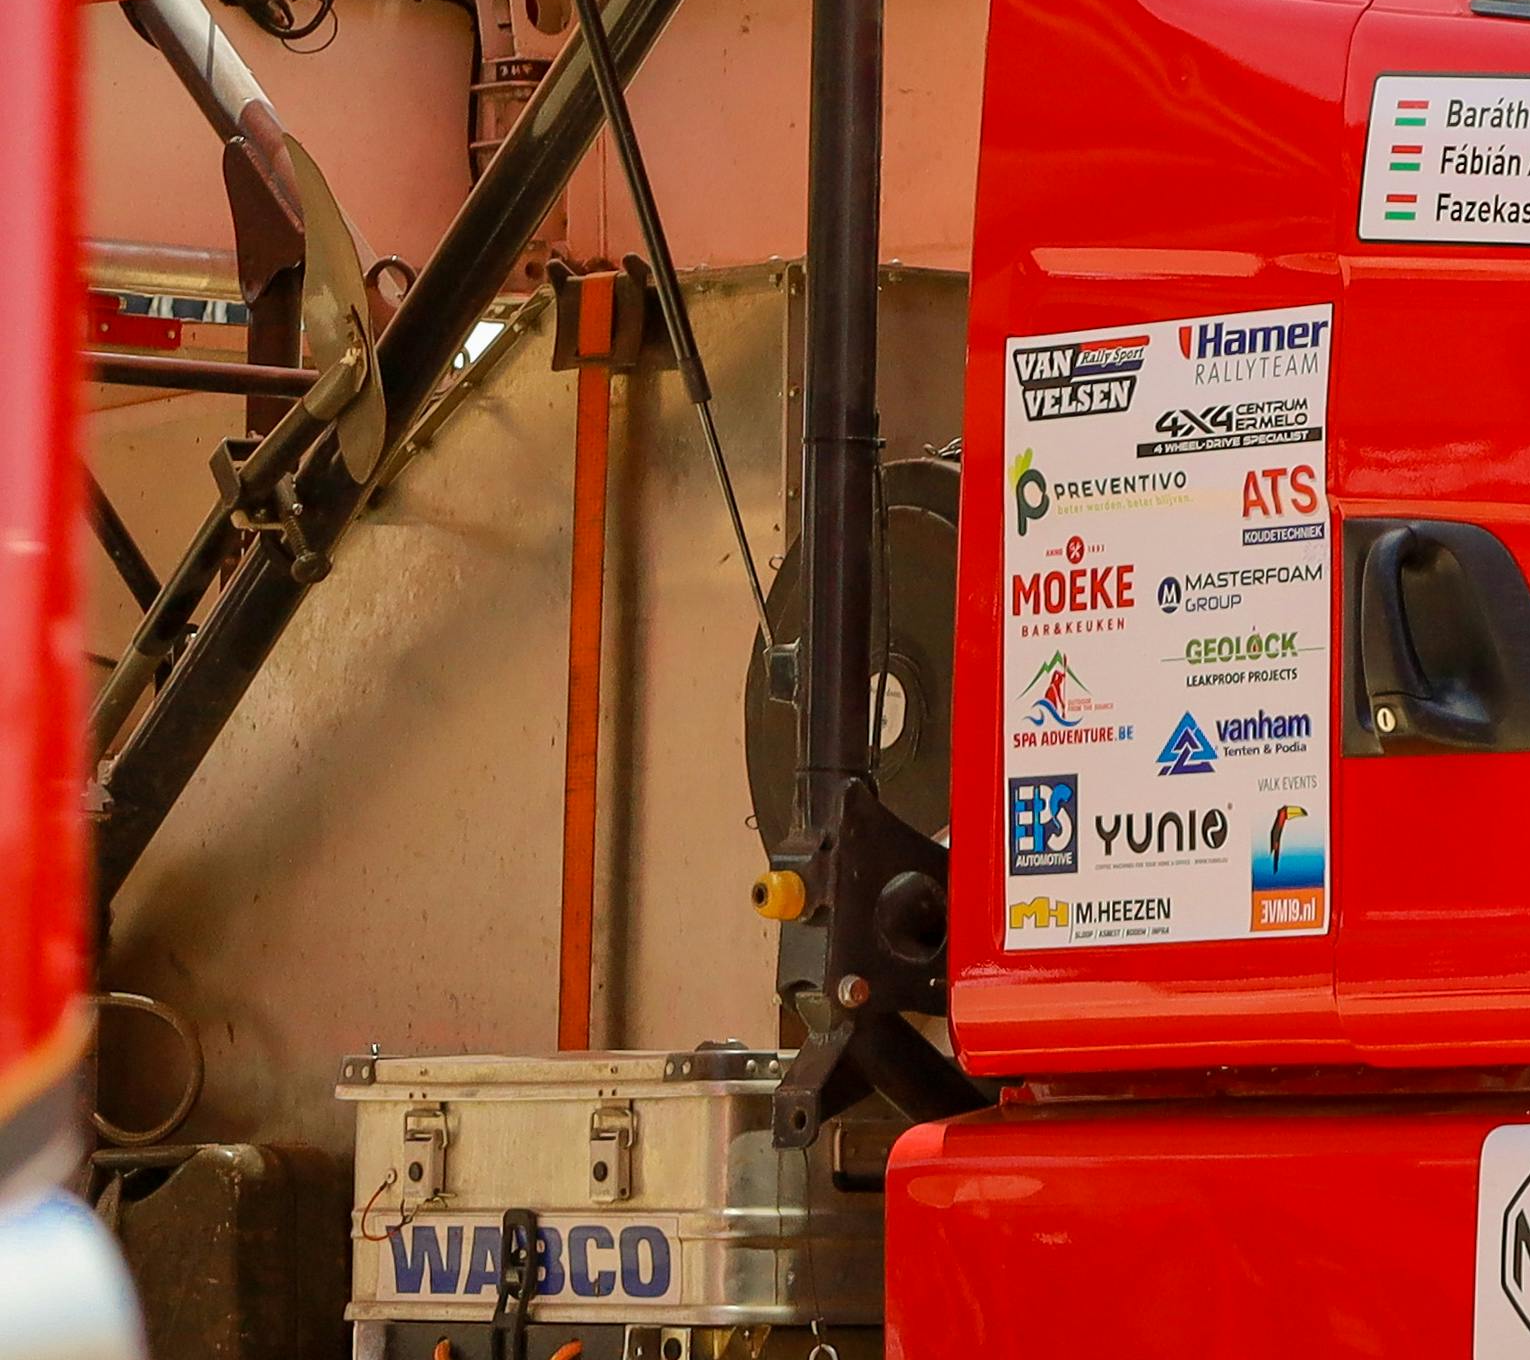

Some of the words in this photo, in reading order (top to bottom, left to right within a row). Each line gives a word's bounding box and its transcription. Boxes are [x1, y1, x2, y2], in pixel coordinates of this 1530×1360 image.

[1446, 97, 1529, 130] Baráth
[1440, 143, 1520, 176] Fábián
[1198, 320, 1329, 360] Hamer
[1015, 348, 1074, 383] VAN
[1080, 349, 1112, 367] Rally
[1111, 346, 1146, 362] Sport
[1195, 352, 1319, 385] RALLYTEAM
[1023, 380, 1132, 418] VELSEN
[1235, 398, 1308, 415] CENTRUM
[1235, 412, 1308, 431] ERMELO
[1153, 444, 1163, 455] 4
[1242, 430, 1311, 447] SPECIALIST
[1054, 471, 1187, 500] PREVENTIVO
[1242, 465, 1318, 519] ATS
[1244, 523, 1323, 545] KOUDETECHNIEK
[1012, 564, 1134, 616] MOEKE
[1185, 563, 1323, 590] MASTERFOAM
[1185, 594, 1242, 612] GROUP
[1021, 617, 1125, 637] BAR&KEUKEN
[1186, 630, 1299, 665] GEOLOCK
[1186, 670, 1246, 687] LEAKPROOF
[1248, 667, 1298, 682] PROJECTS
[1216, 709, 1311, 742] vanham
[1013, 731, 1038, 748] SPA
[1223, 745, 1260, 757] Tenten
[1263, 744, 1272, 755] &
[1275, 742, 1307, 755] Podia
[1258, 777, 1281, 792] VALK
[1282, 775, 1318, 791] EVENTS
[1015, 851, 1073, 867] AUTOMOTIVE
[1076, 897, 1171, 924] M.HEEZEN
[386, 1224, 672, 1299] WABCO
